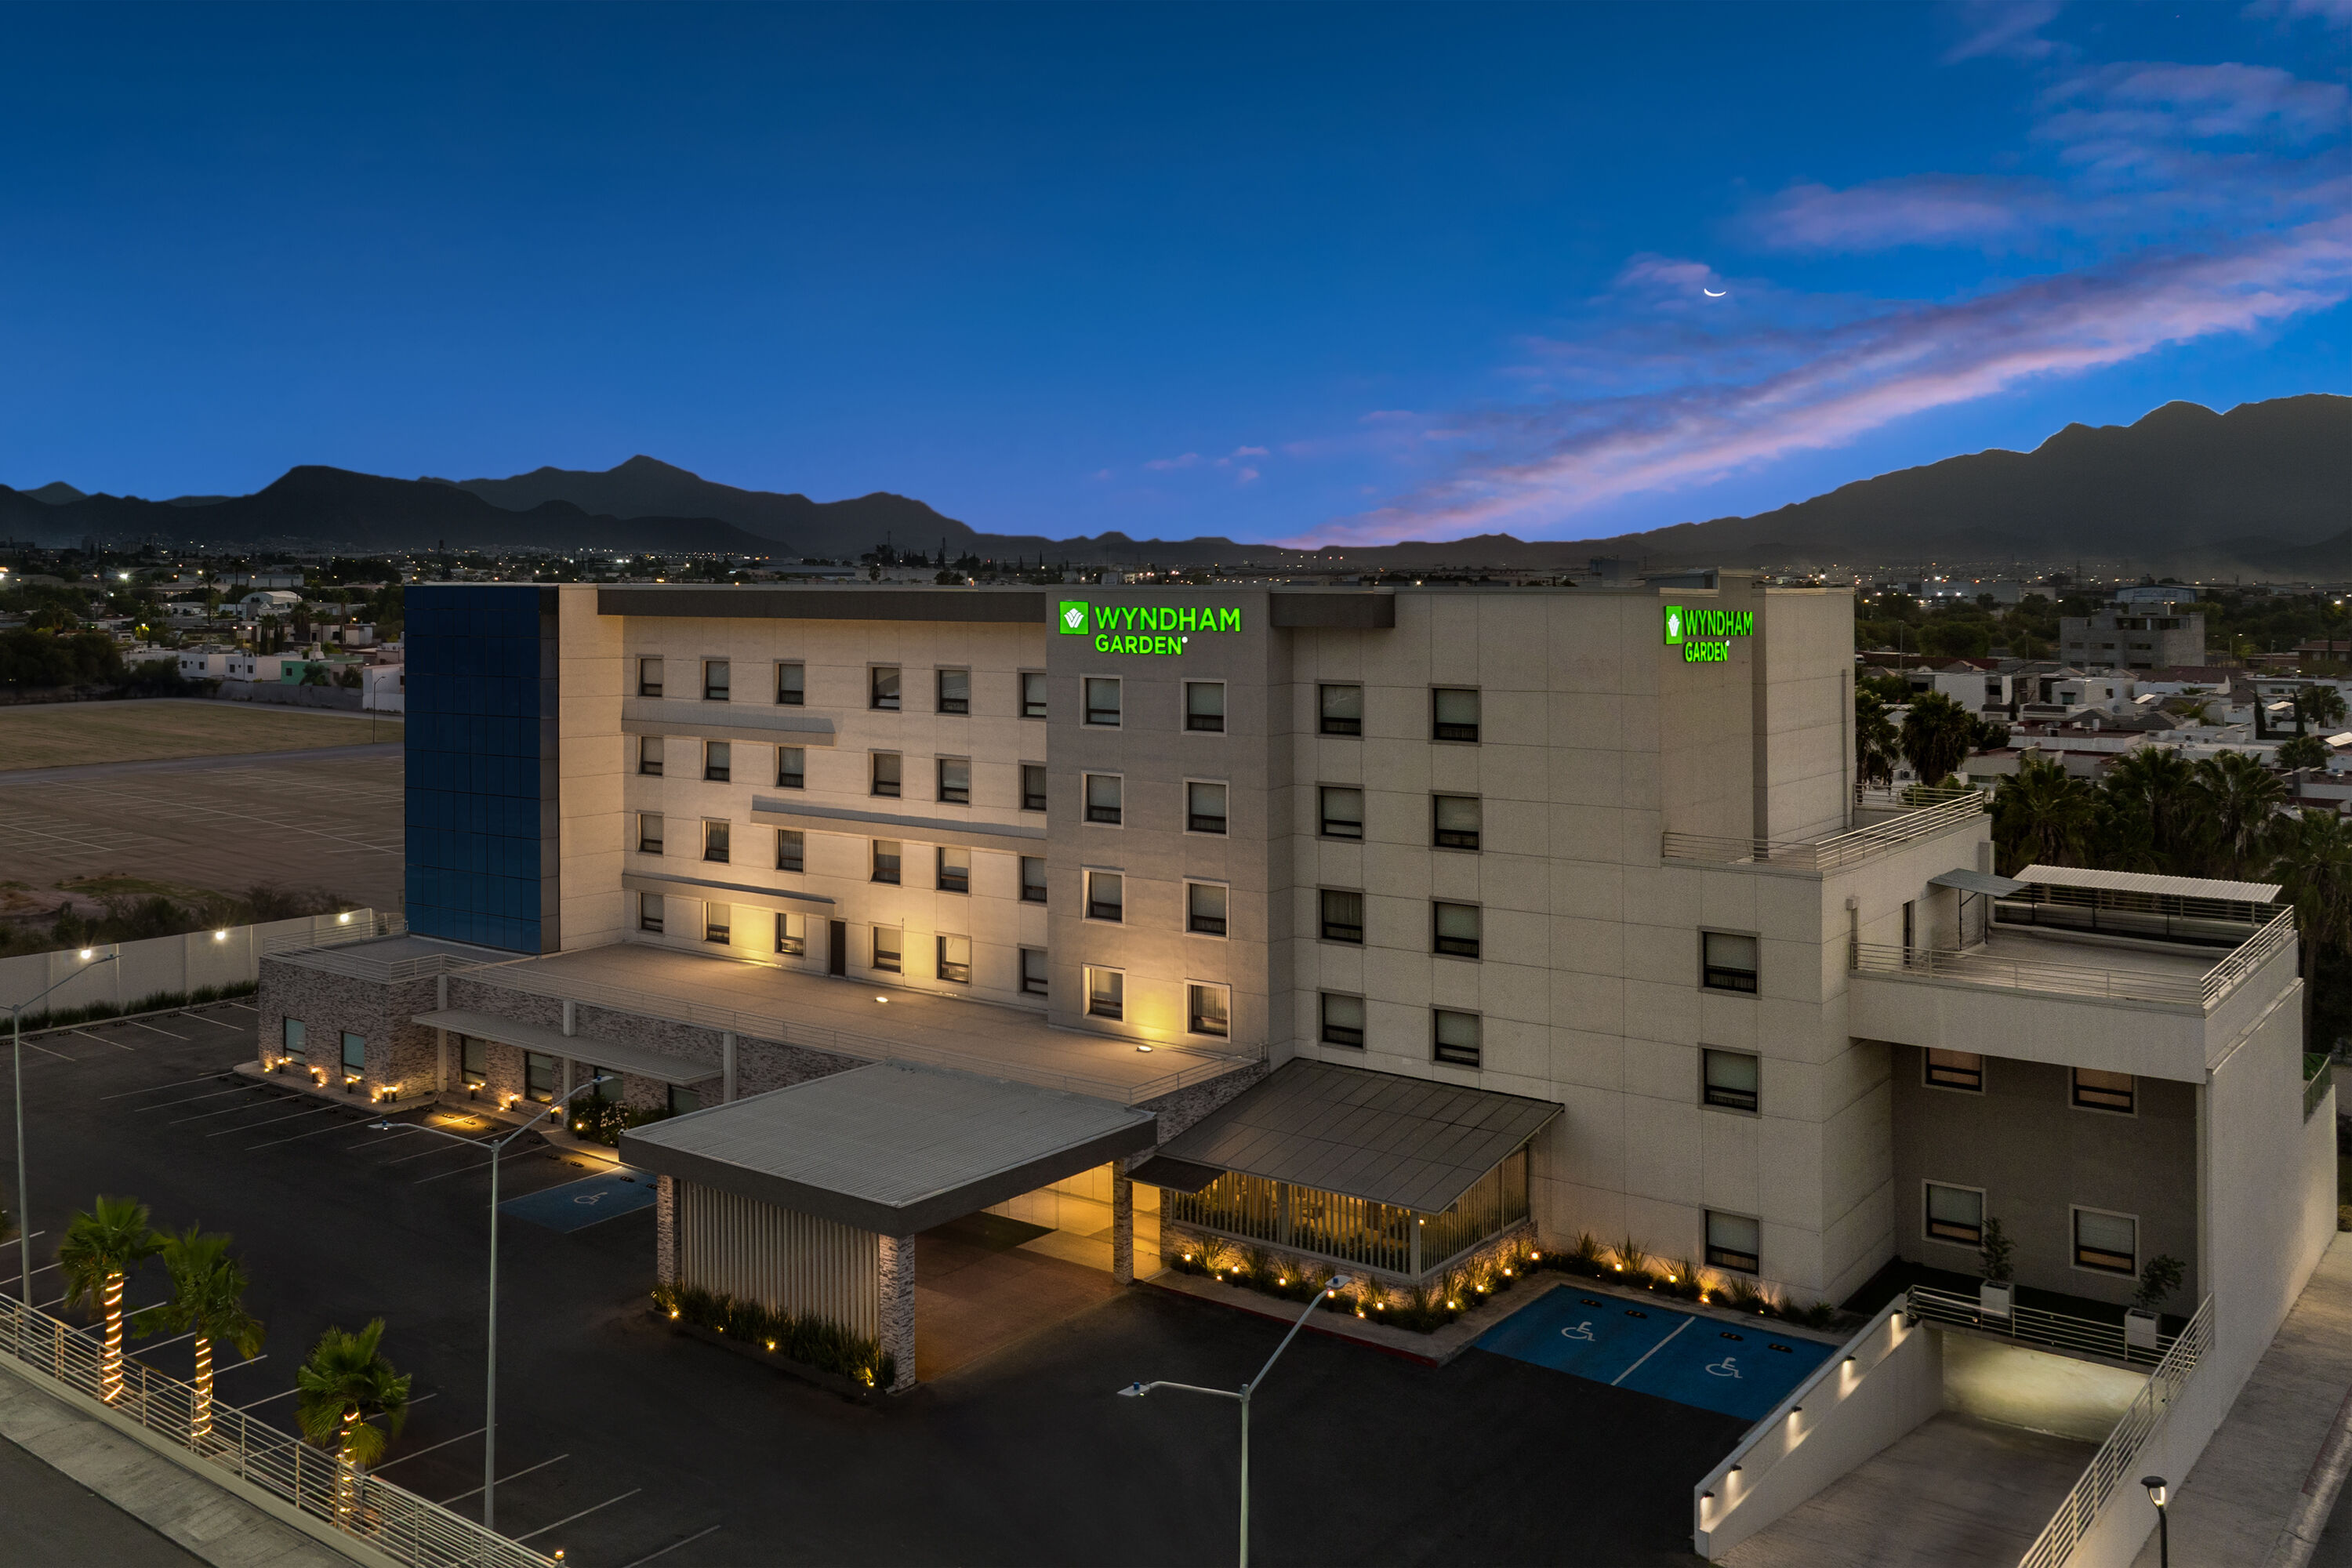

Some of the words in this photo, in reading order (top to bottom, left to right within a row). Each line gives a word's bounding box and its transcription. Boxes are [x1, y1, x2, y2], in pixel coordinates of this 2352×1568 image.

[1094, 606, 1241, 632] WYNDHAM
[1685, 610, 1754, 636] WYNDHAM
[1094, 633, 1182, 655] GARDEN
[1685, 641, 1728, 662] GARDEN
